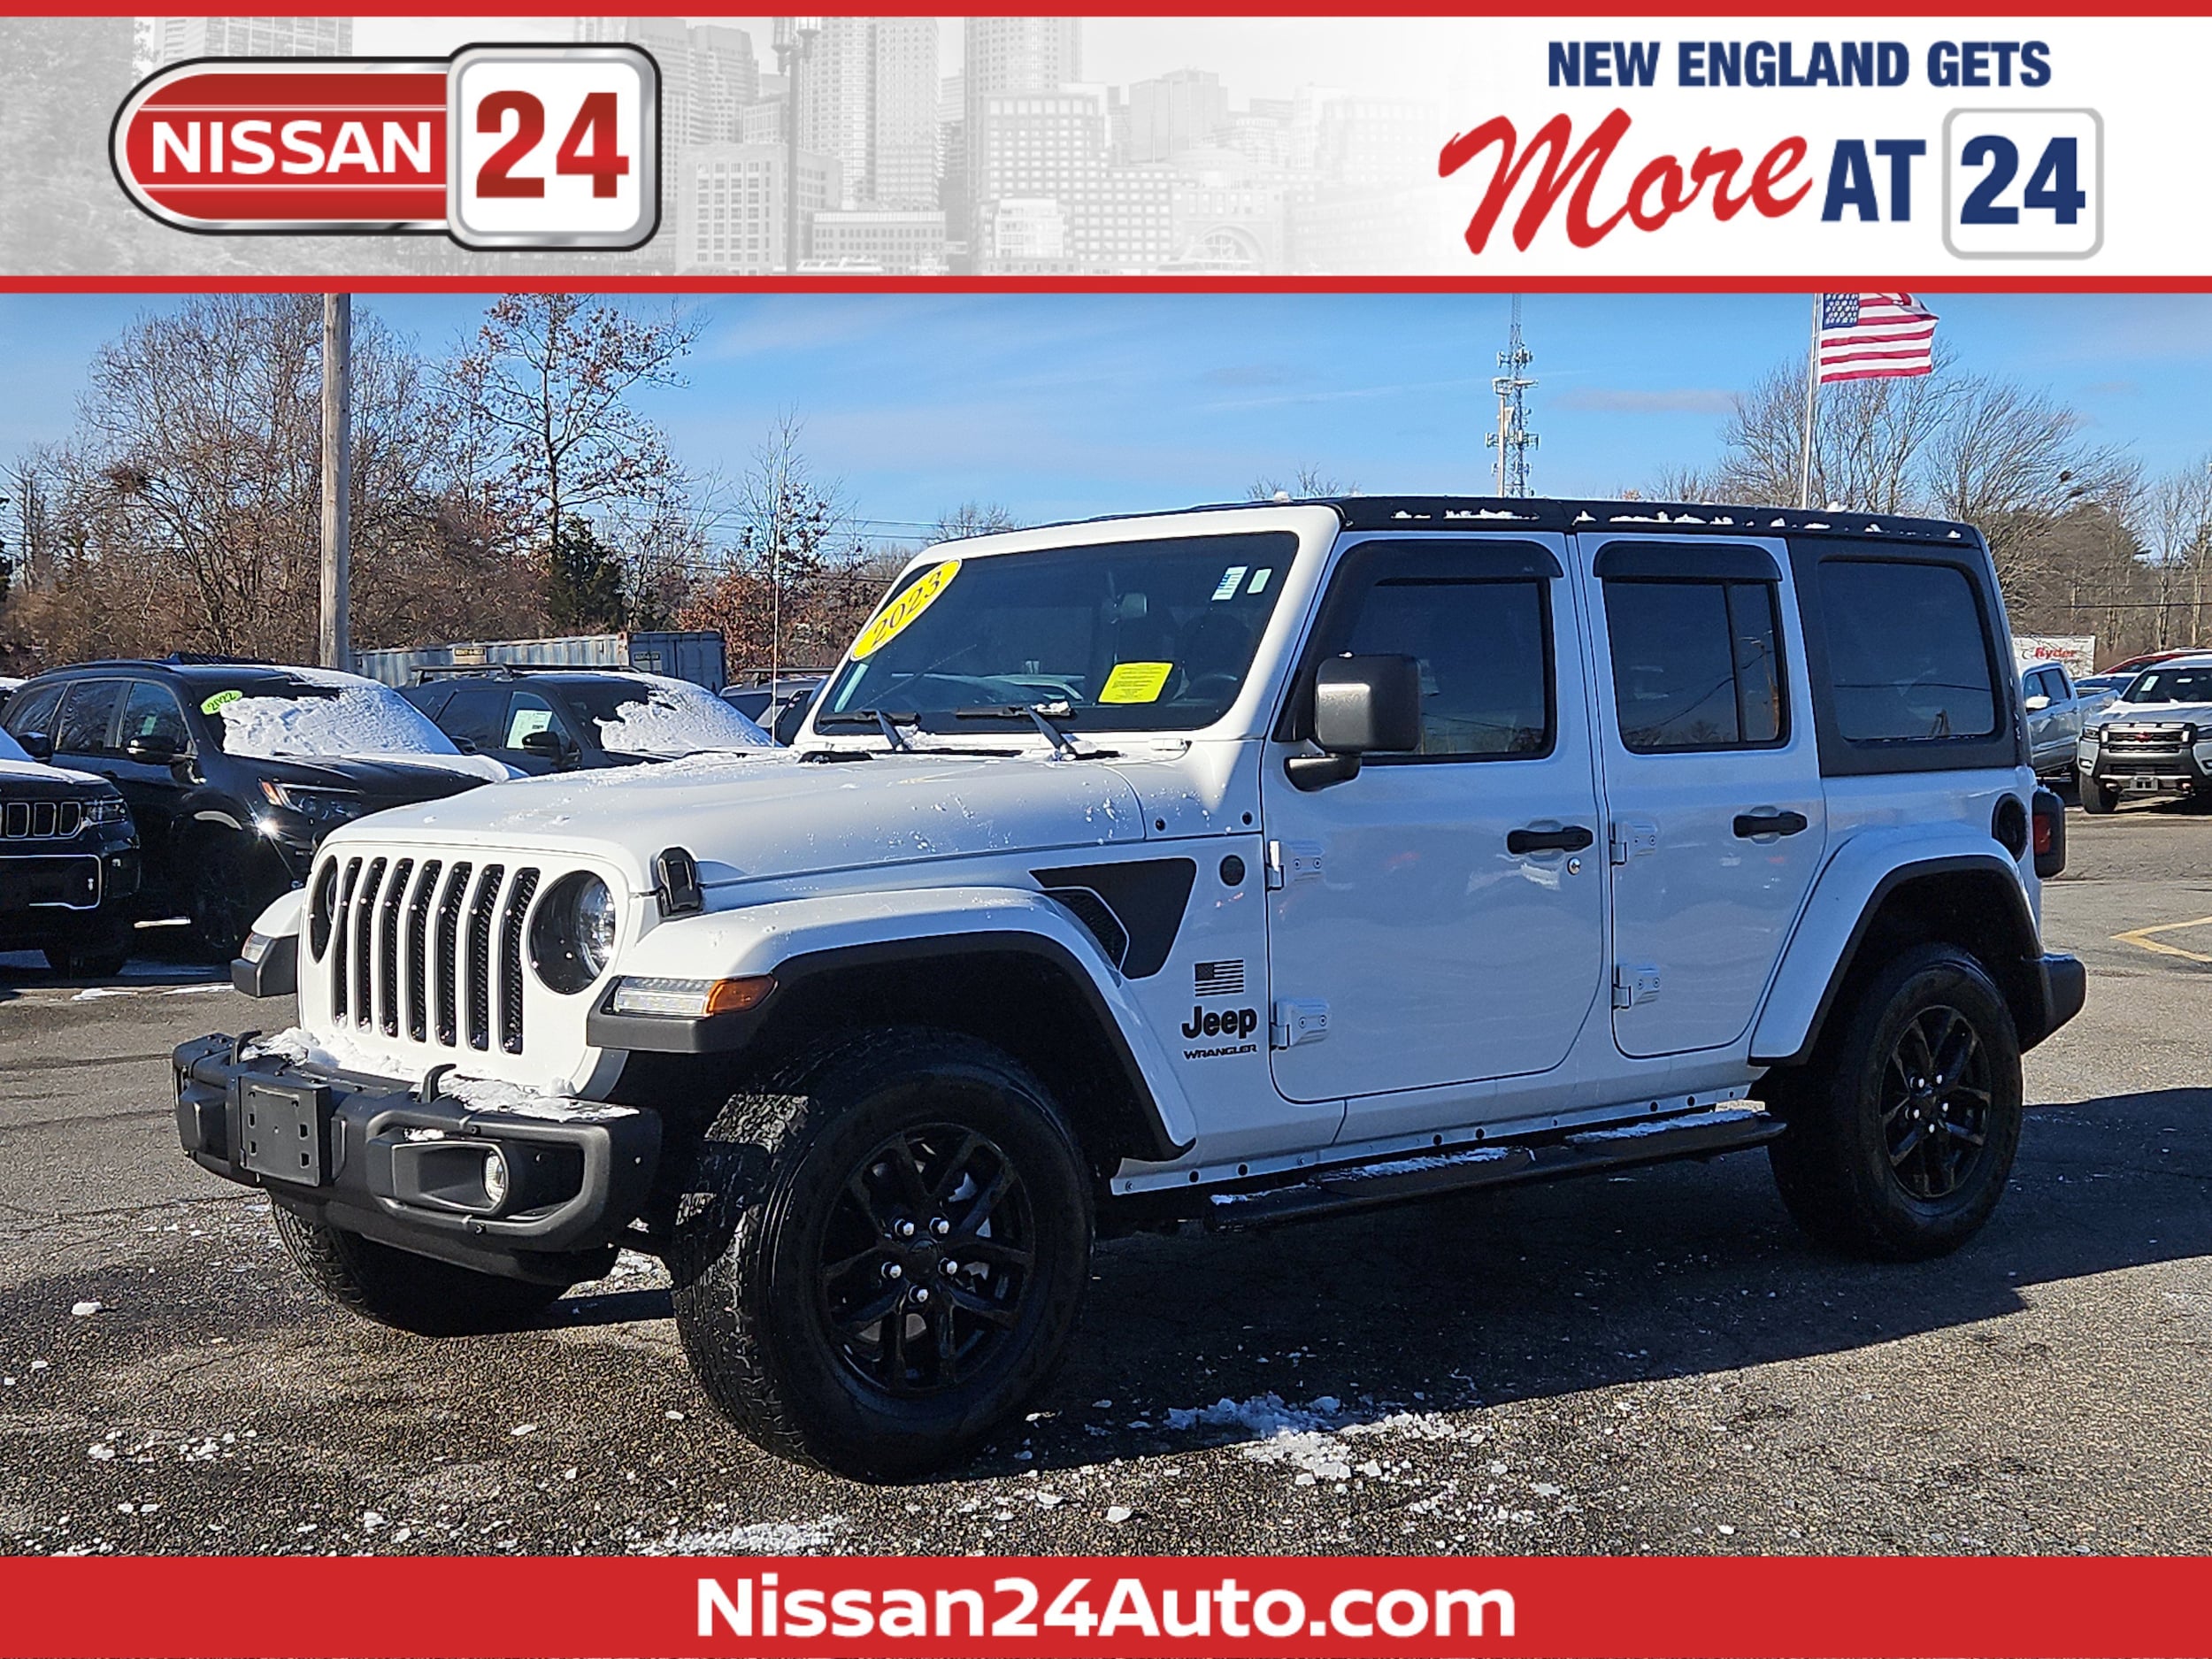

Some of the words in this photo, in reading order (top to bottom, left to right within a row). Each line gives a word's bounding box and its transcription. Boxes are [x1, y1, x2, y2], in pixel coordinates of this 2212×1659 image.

[870, 570, 942, 649] 2023
[1181, 1005, 1257, 1039] Jeep
[1183, 1044, 1257, 1059] WRANGLER
